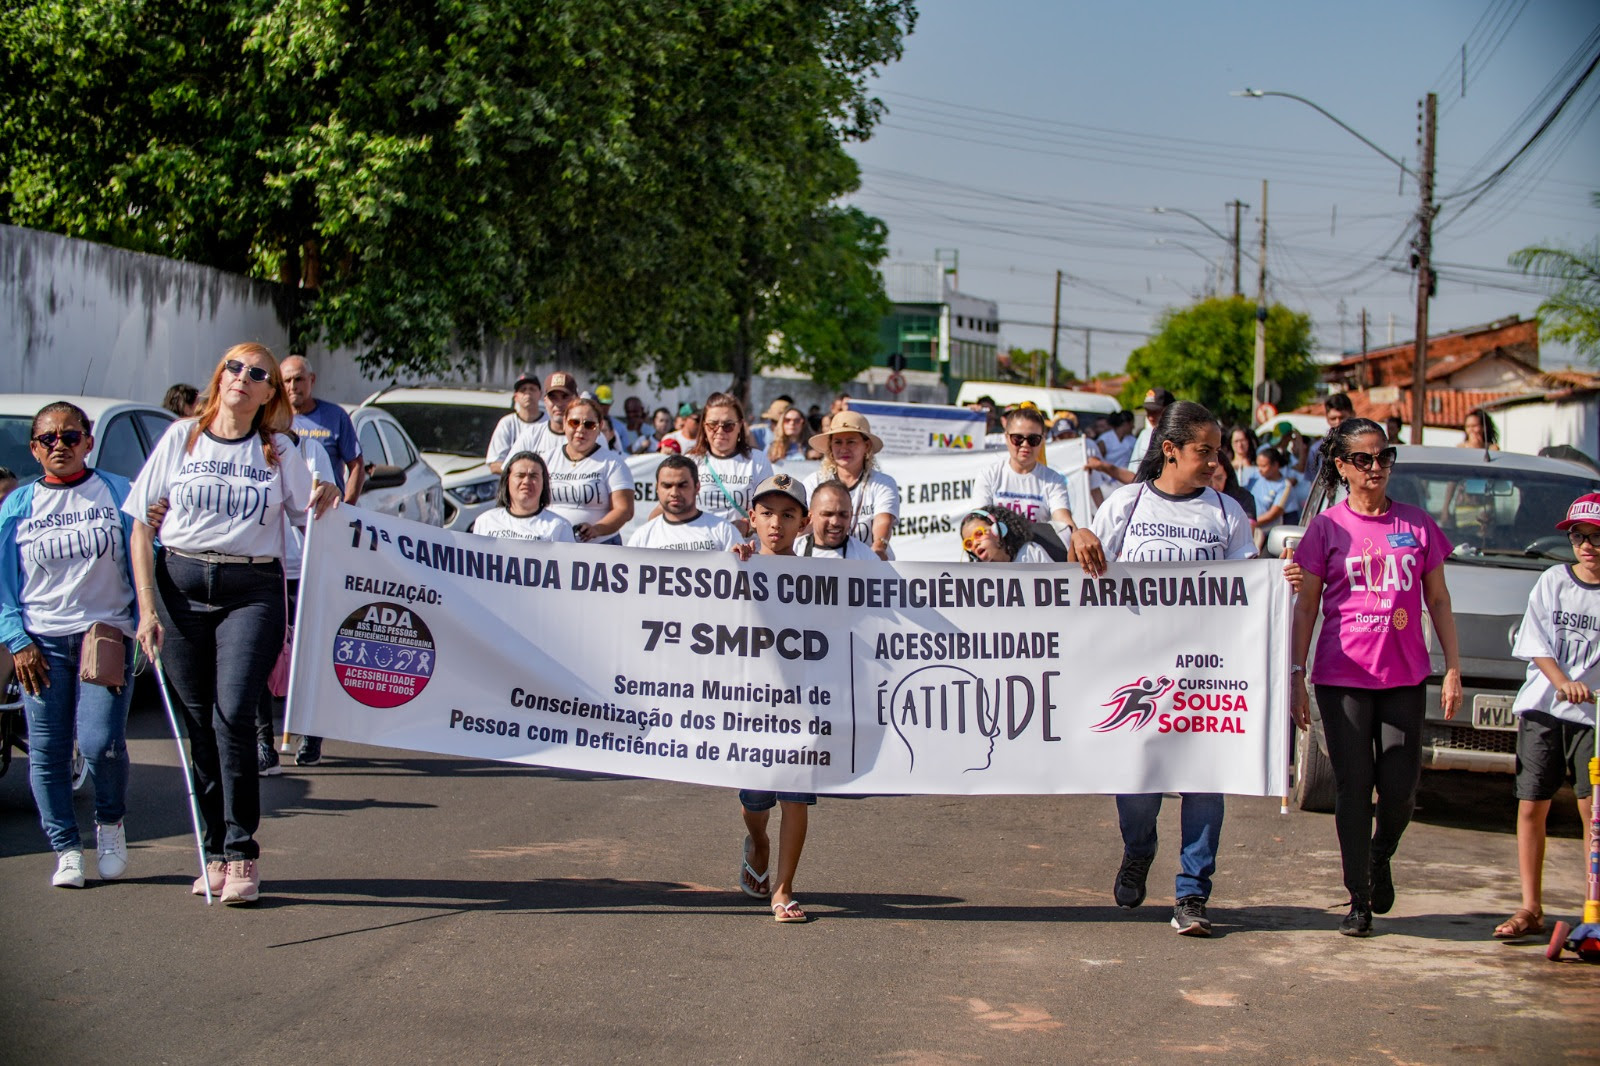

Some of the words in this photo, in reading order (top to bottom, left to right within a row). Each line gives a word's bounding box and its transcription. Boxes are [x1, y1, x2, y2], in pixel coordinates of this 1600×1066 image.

[178, 461, 274, 482] ACESSIBILIDADE
[551, 482, 603, 504] TITUDE
[186, 483, 272, 526] ATITUDE
[349, 518, 392, 551] 11ª
[400, 535, 562, 590] CAMINHADA
[571, 561, 629, 594] DAS
[638, 565, 769, 601] PESSOAS
[777, 574, 838, 606] COM
[849, 572, 1025, 608] DEFICIÊNCIA
[1034, 578, 1070, 606] DE
[1080, 570, 1248, 606] ARAGUAÍNA
[1345, 554, 1416, 591] ELAS
[344, 575, 442, 605] REALIZAÇÃO:
[363, 606, 413, 629] ADA
[1355, 613, 1390, 625] Rotary
[340, 628, 354, 636] COM
[354, 629, 389, 642] DEFICIÊNCIA
[398, 636, 432, 648] ARAGUAÍNA
[356, 622, 372, 631] ASS.
[373, 623, 386, 633] DAS
[387, 626, 418, 638] PESSOAS
[641, 620, 682, 652] 7ª
[690, 623, 829, 661] SMPCD
[875, 632, 1060, 660] ACESSIBILIDADE
[1175, 654, 1224, 668] APOIO:
[344, 678, 374, 690] DIREITO
[376, 682, 386, 692] DE
[388, 684, 415, 696] TODOS
[345, 668, 416, 686] ACESSIBILIDADE
[1178, 678, 1248, 691] CURSINHO
[614, 674, 694, 699] Semana
[702, 680, 801, 706] Municipal
[808, 686, 831, 706] de
[510, 687, 673, 731] Conscientização
[680, 708, 716, 731] dos
[722, 711, 801, 735] Direitos
[808, 715, 832, 736] da
[877, 680, 888, 726] É
[901, 671, 1061, 742] ATITUDE
[1173, 691, 1248, 712] SOUSA
[1158, 713, 1246, 734] SOBRAL
[449, 709, 520, 738] Pessoa
[527, 726, 568, 745] com
[575, 727, 688, 760] Deficiência
[695, 739, 720, 762] de
[726, 742, 831, 768] Araguaína
